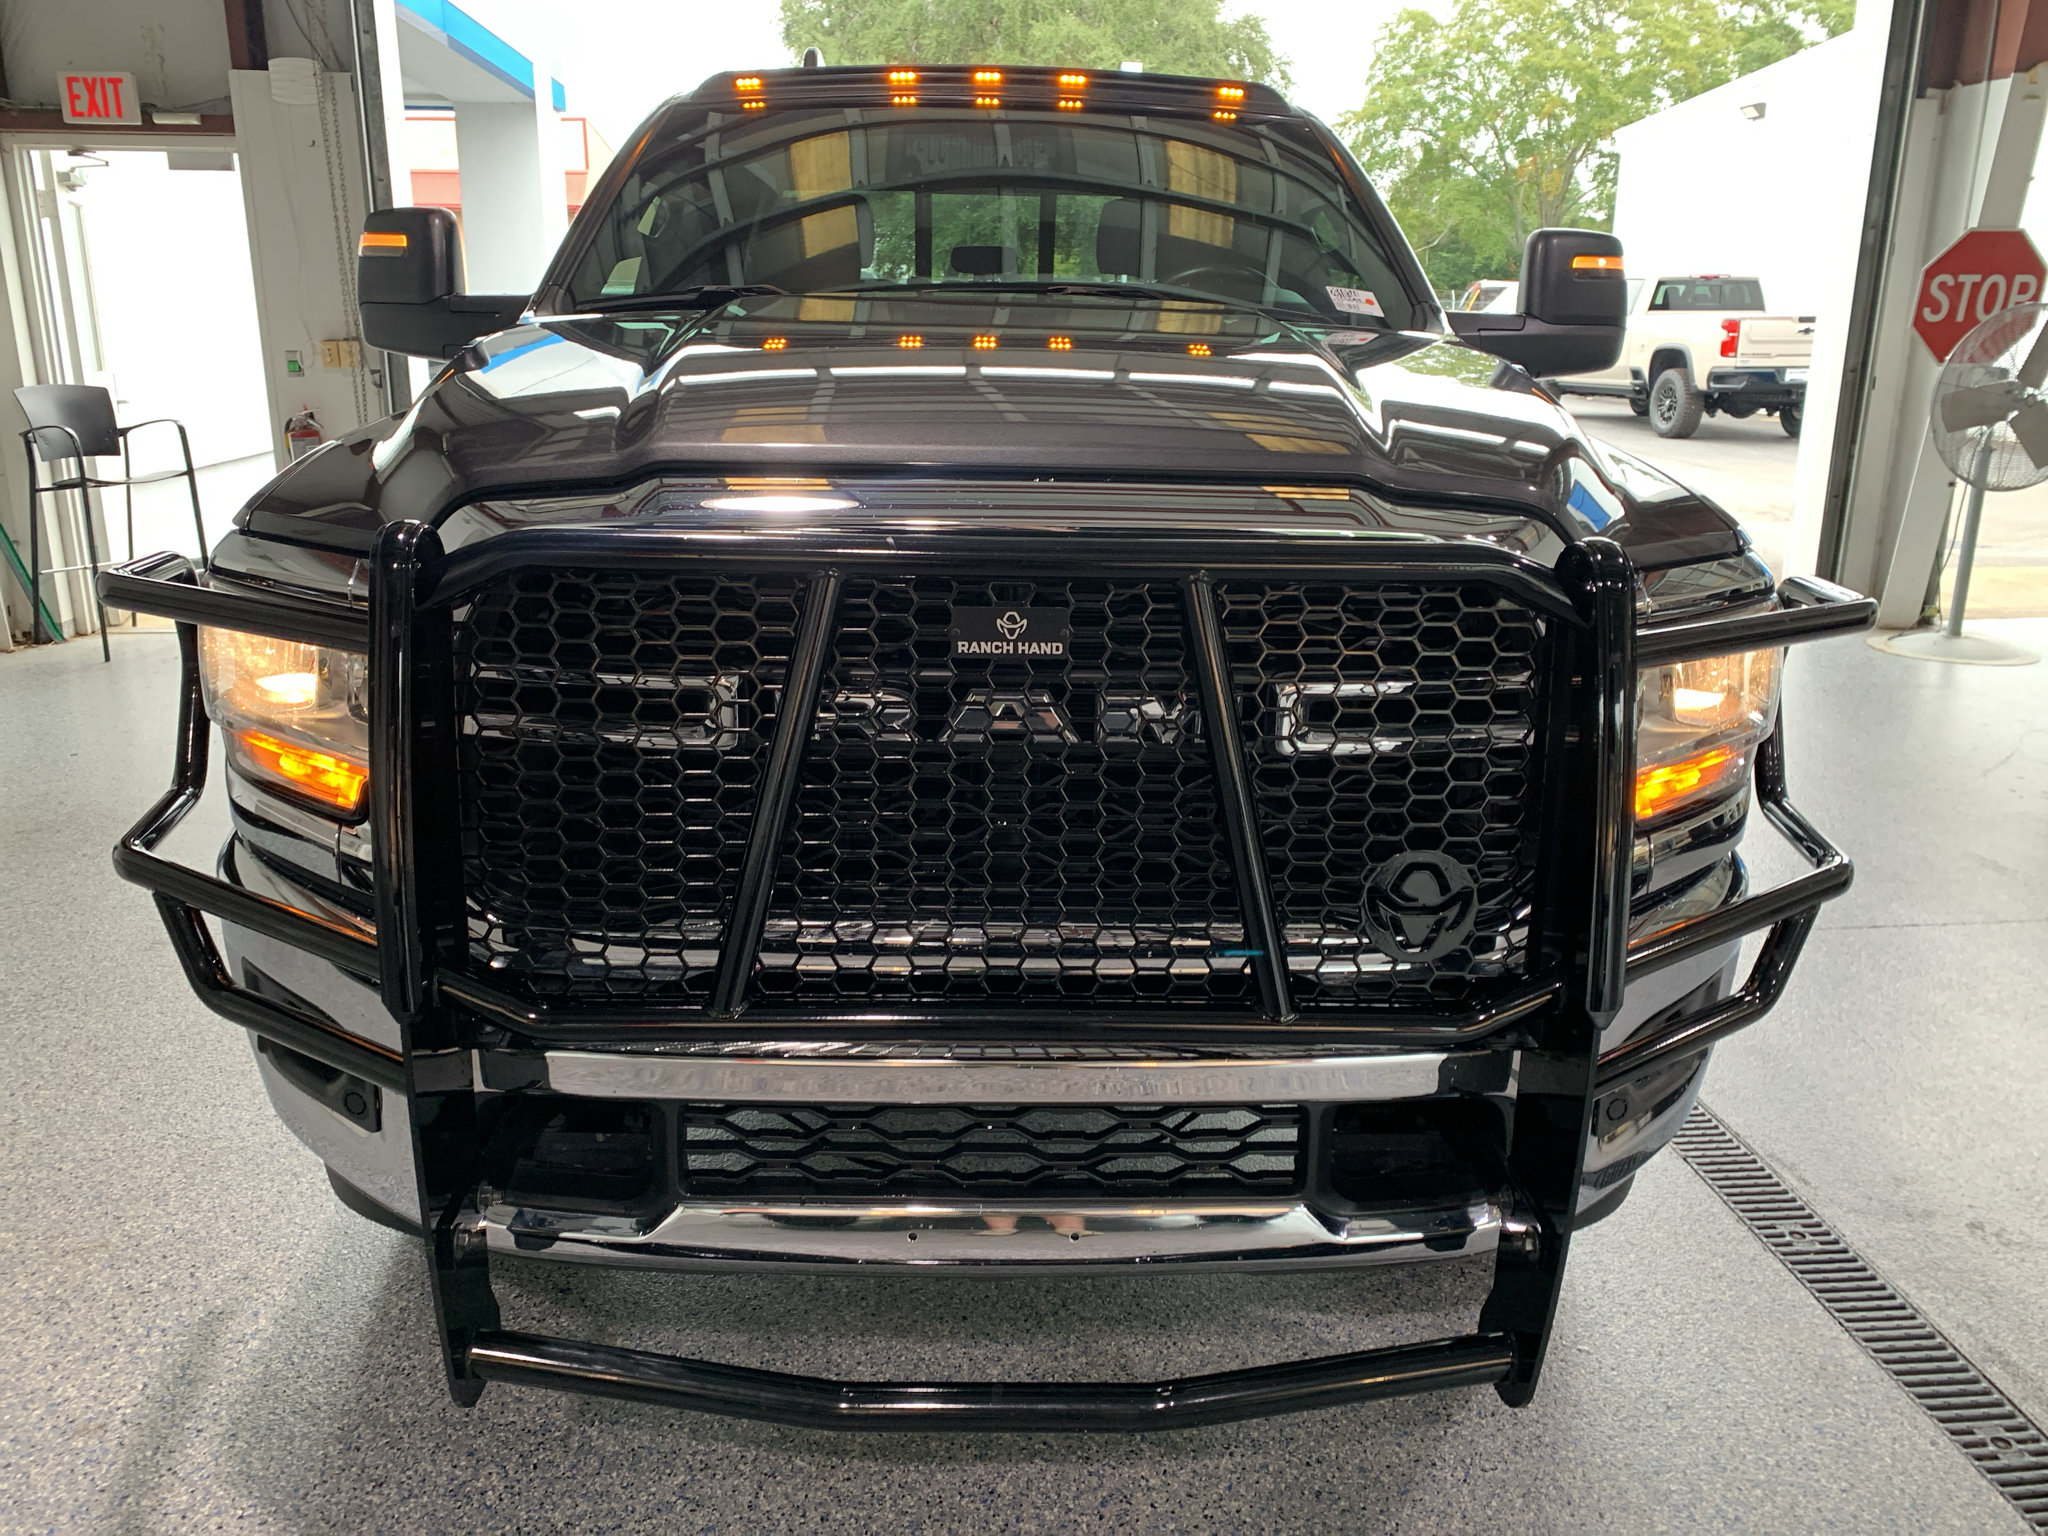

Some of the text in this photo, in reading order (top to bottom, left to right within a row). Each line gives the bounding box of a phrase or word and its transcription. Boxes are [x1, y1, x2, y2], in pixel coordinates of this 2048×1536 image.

[66, 76, 123, 118] EXIT
[1922, 273, 2038, 323] STOP
[957, 641, 1064, 655] RANCH HAND
